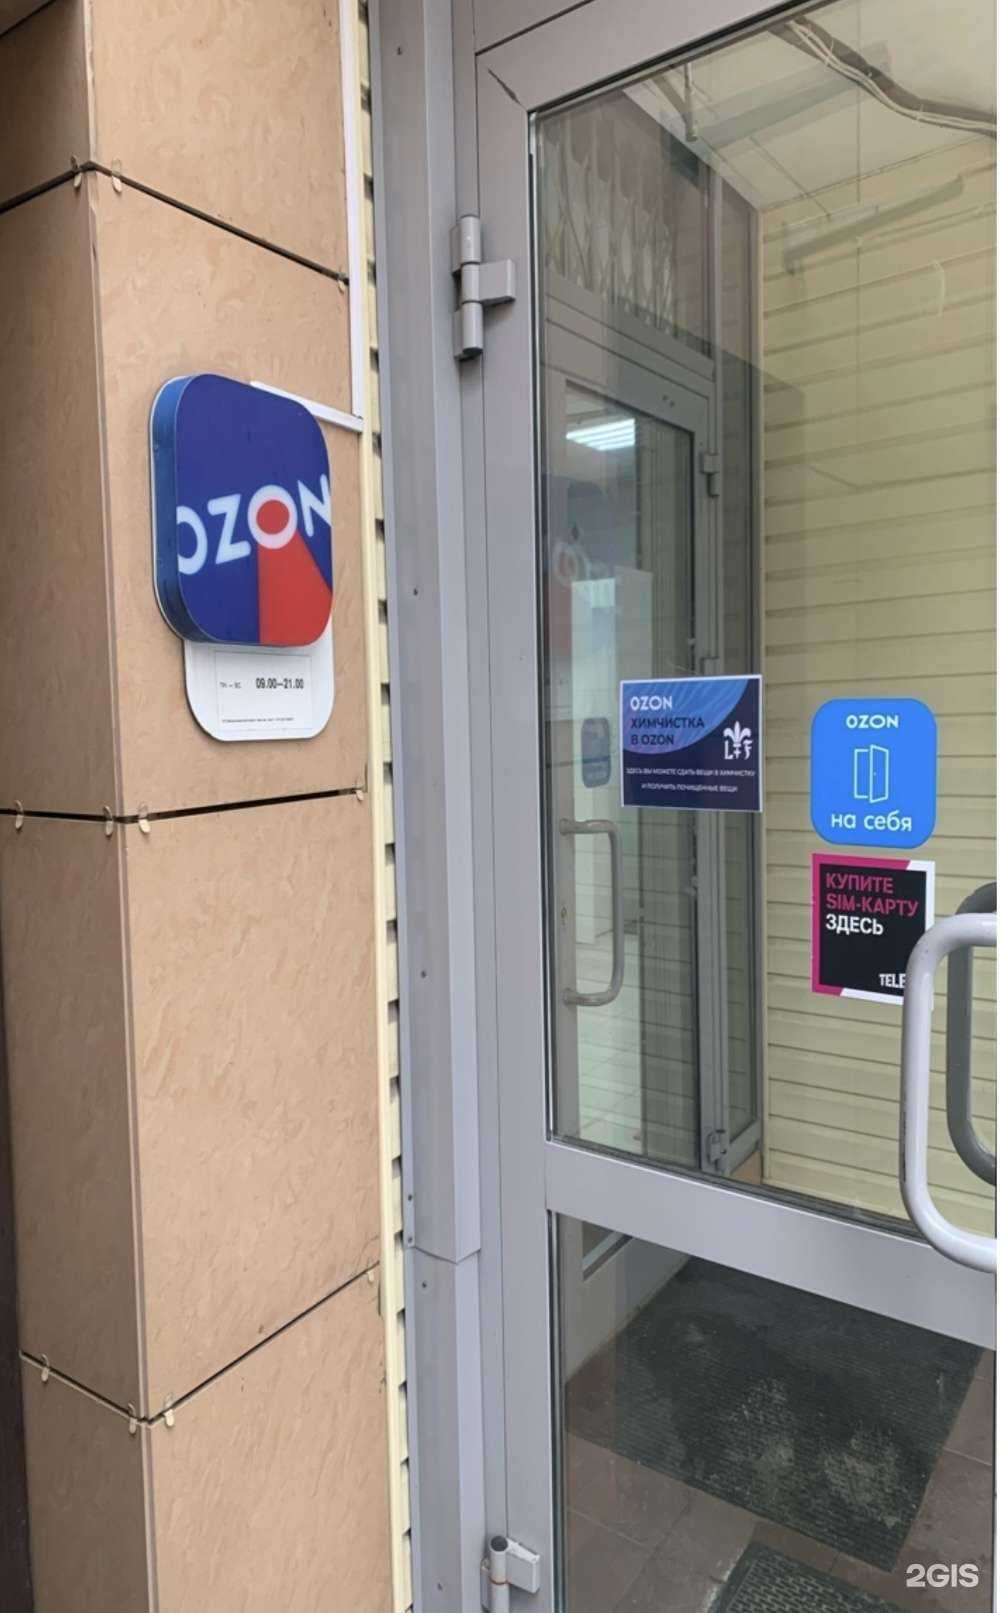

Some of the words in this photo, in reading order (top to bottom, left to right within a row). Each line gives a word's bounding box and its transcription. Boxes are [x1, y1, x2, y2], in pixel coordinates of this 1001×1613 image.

[176, 474, 332, 575] OZON
[630, 695, 673, 711] OZON
[631, 717, 705, 729] ХИМЧИСТКА
[846, 715, 899, 729] OZON
[631, 734, 639, 746] В
[641, 734, 675, 746] OZON
[831, 813, 857, 829] на
[863, 810, 912, 832] себя
[825, 873, 894, 894] КУПИТЕ
[826, 893, 918, 917] SIM-КАРТУ
[825, 914, 884, 936] ЗДЕСЬ
[879, 973, 906, 989] TELE
